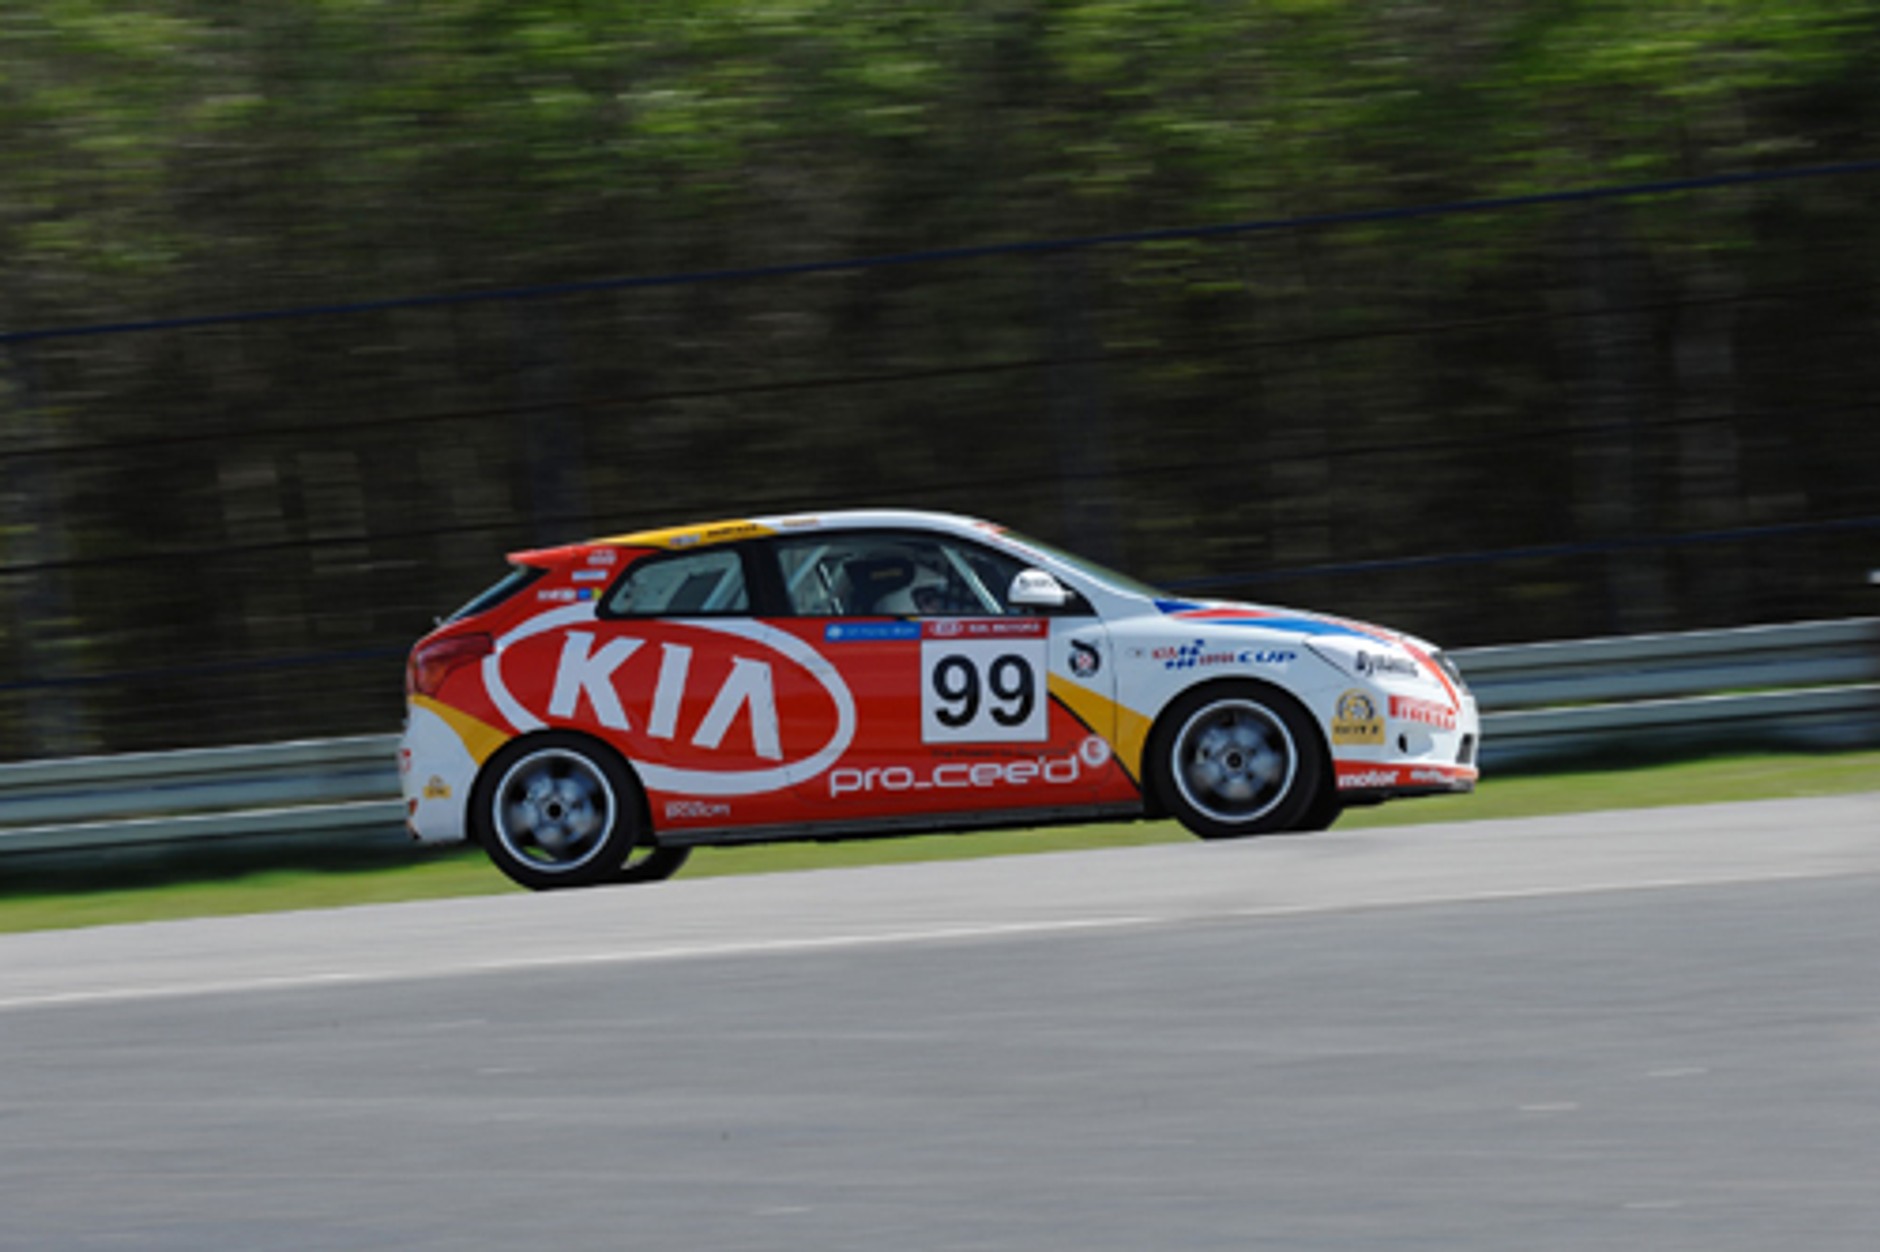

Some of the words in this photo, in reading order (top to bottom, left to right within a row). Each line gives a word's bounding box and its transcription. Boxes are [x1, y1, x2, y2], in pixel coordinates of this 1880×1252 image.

[932, 654, 1036, 728] 99
[1238, 650, 1297, 663] CUP
[548, 630, 783, 761] KIA
